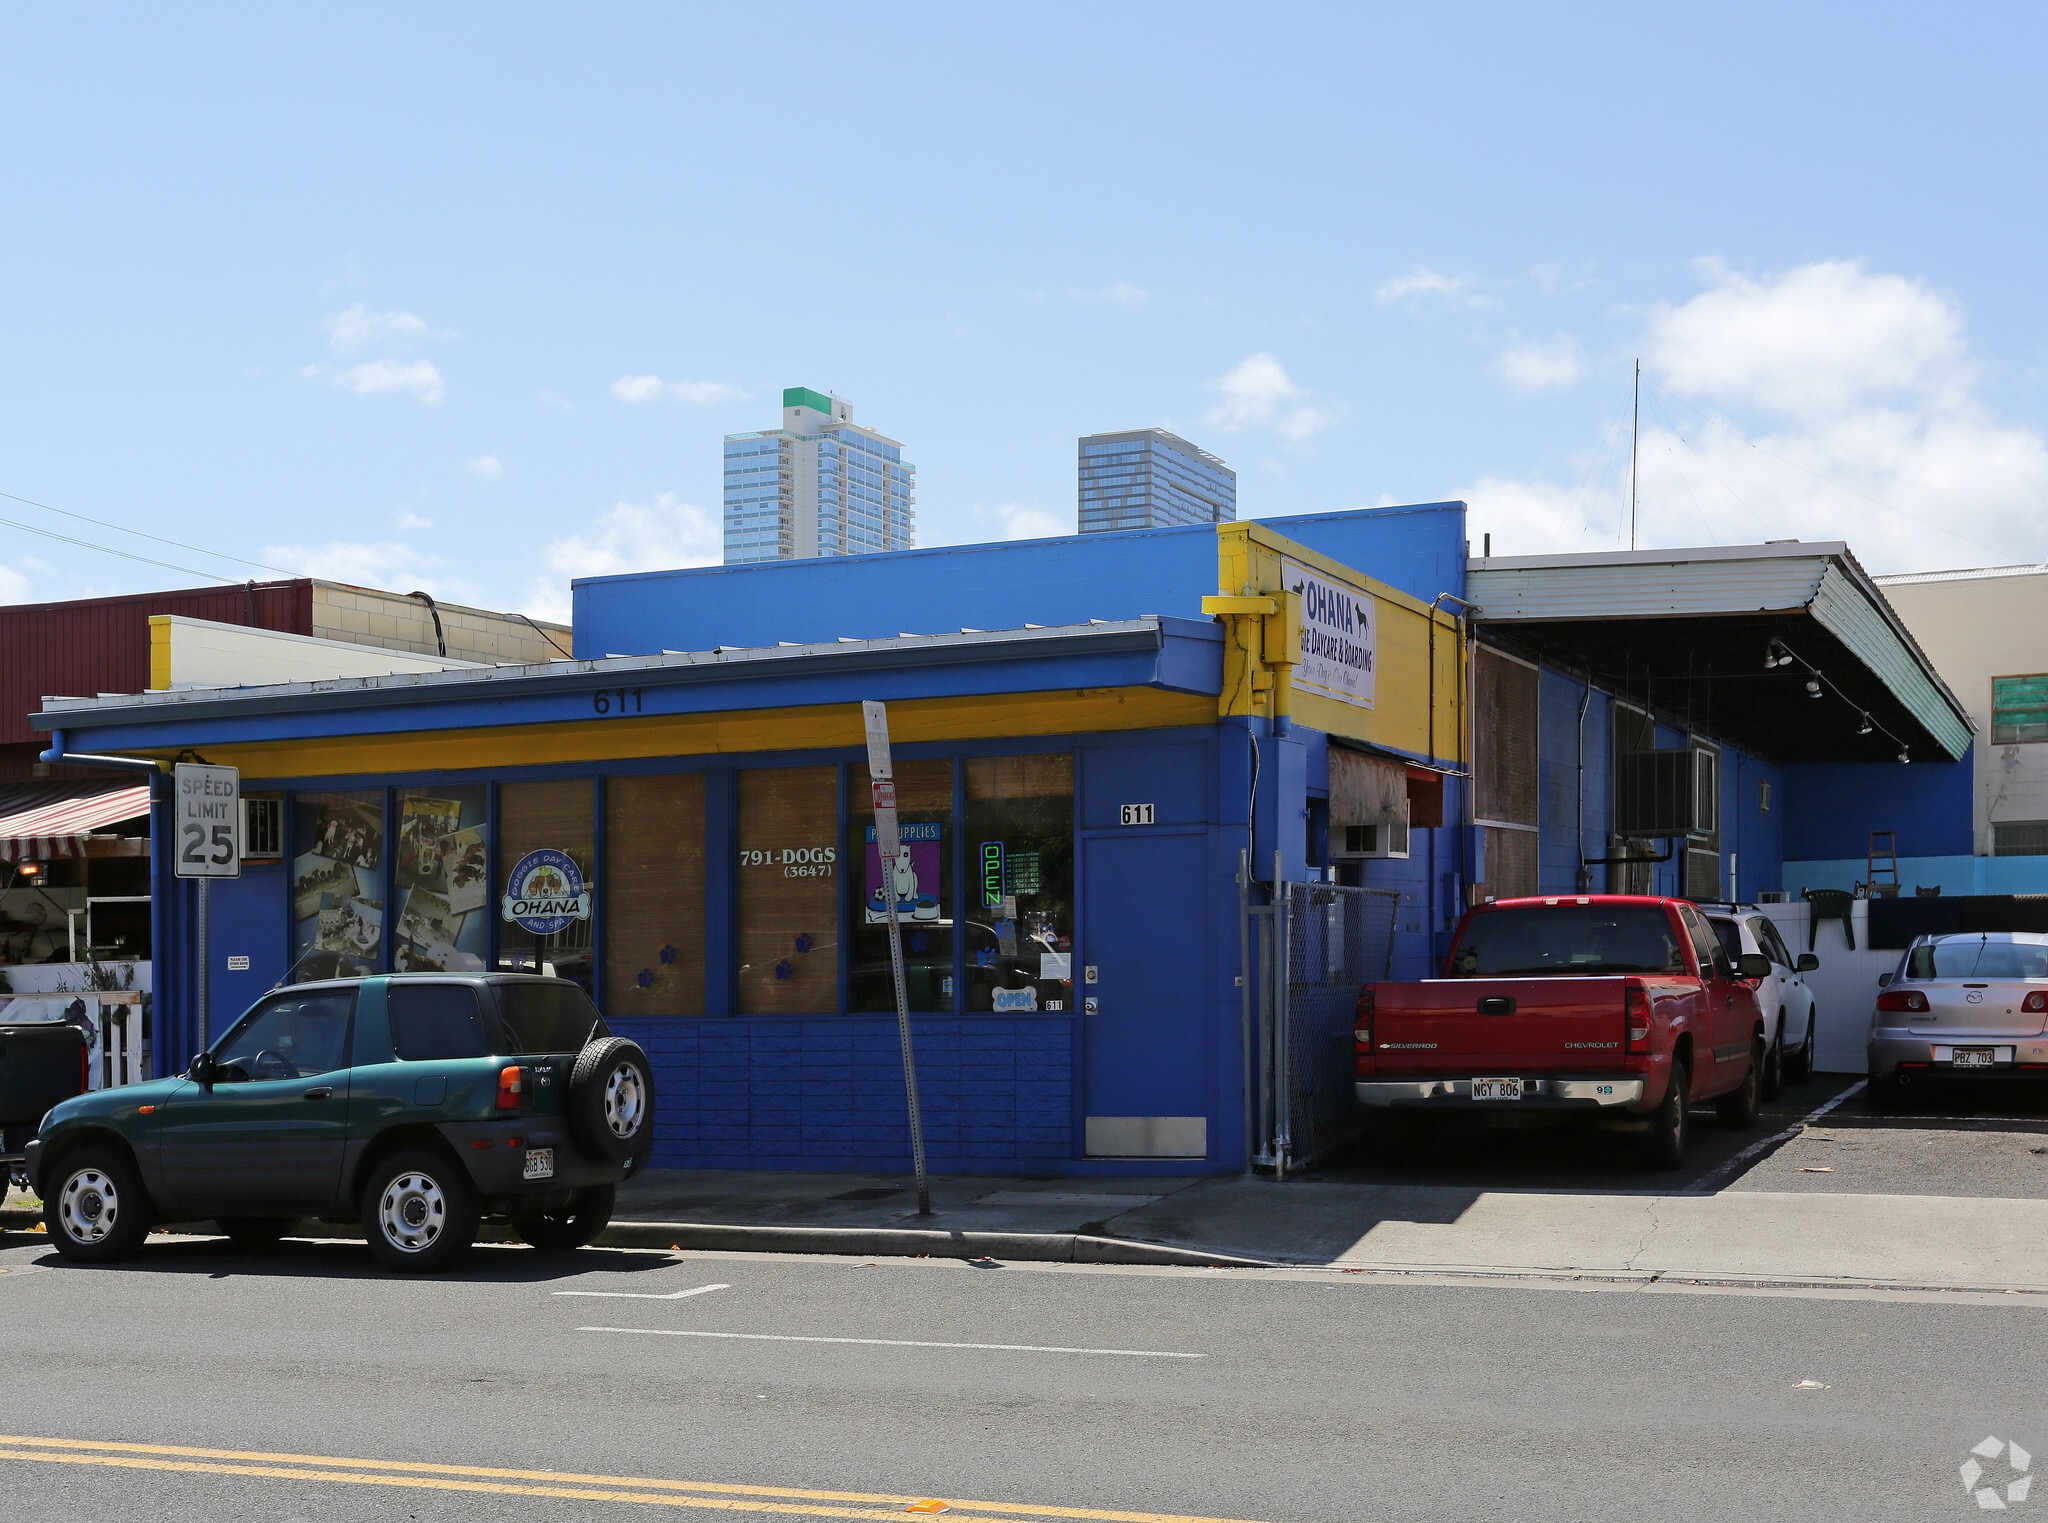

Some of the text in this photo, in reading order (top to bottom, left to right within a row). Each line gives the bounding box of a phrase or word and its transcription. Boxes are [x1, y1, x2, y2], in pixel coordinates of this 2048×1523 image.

[1307, 580, 1353, 634] OHANA
[1338, 637, 1344, 664] &
[1344, 639, 1372, 673] BOARDING
[594, 688, 642, 715] 611
[182, 779, 233, 797] SPEED
[187, 801, 228, 819] LIMIT
[1122, 804, 1152, 824] 611
[898, 825, 936, 839] UPPLIES
[182, 823, 233, 865] 25
[740, 846, 836, 866] 791-DOGS
[512, 855, 580, 896] DOGGIE DAY CARE
[784, 864, 832, 878] (3647)
[985, 846, 1000, 905] OPEN
[512, 900, 580, 915] OHANA
[527, 917, 565, 929] AND SPA
[997, 992, 1032, 1007] OPEN
[1047, 1001, 1062, 1010] 611
[1954, 1052, 1993, 1064] PBZ 703
[1474, 1083, 1519, 1096] NGY 806
